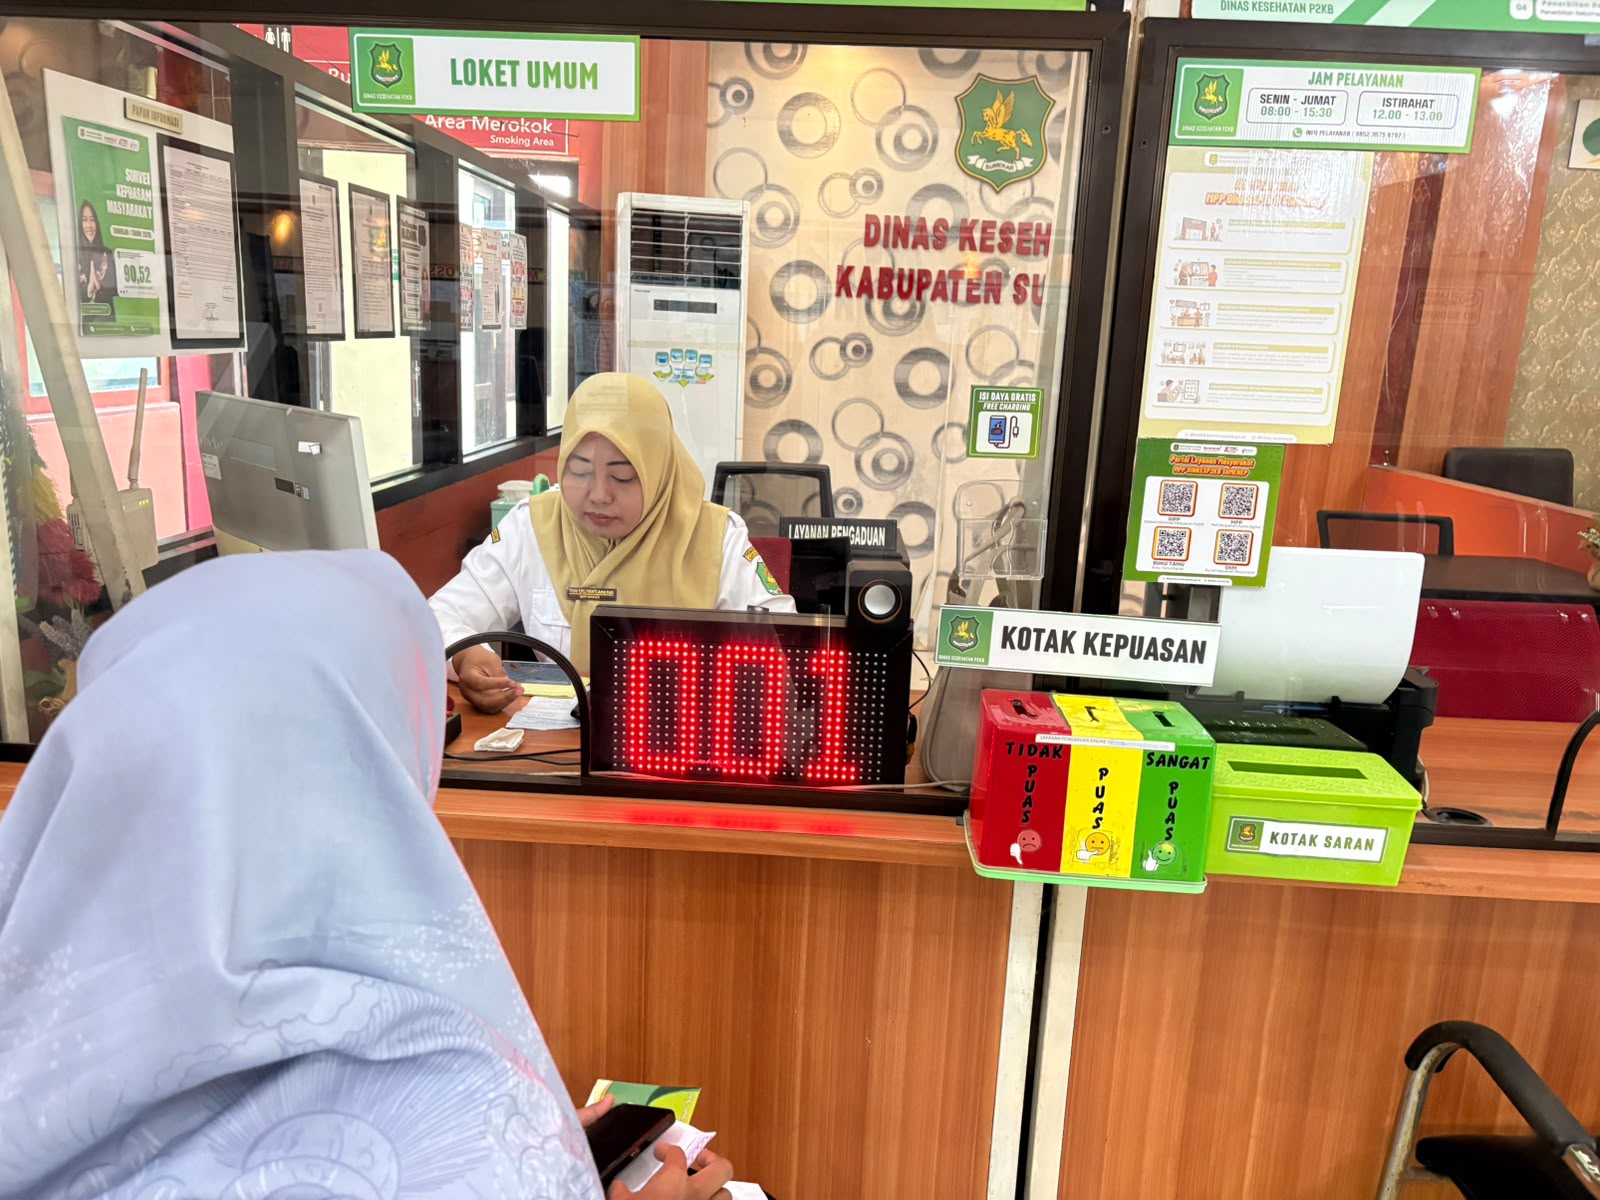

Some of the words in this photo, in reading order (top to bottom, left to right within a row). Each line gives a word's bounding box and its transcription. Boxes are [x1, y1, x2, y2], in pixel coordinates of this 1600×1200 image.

[1220, 0, 1249, 11] DINAS
[1251, 1, 1306, 13] KESEHATAN
[1309, 3, 1334, 14] P2KB
[450, 58, 520, 88] LOKET
[527, 60, 598, 90] UMUM
[1308, 71, 1335, 86] JAM
[1336, 72, 1404, 88] PELAYANAN
[1259, 93, 1290, 105] SENIN
[1300, 95, 1337, 106] JUMAT
[1382, 97, 1435, 110] ISTIRAHAT
[1260, 105, 1291, 117] 08:00
[1302, 107, 1333, 118] 15:30
[1372, 109, 1402, 120] 12.00
[1413, 110, 1443, 122] 13.00
[425, 113, 466, 129] Area
[472, 115, 552, 134] Merokok
[490, 134, 531, 147] Smoking
[533, 137, 554, 147] Area
[864, 213, 950, 250] DINAS
[123, 263, 152, 283] 90,52
[836, 264, 1004, 305] KABUPATEN
[979, 391, 990, 400] ISI
[990, 392, 1010, 401] DAYA
[1011, 393, 1036, 402] GRATIS
[983, 402, 999, 411] FREE
[999, 402, 1031, 411] CHARGING
[788, 524, 830, 539] LAYANAN
[831, 525, 886, 547] PENGADUAN
[1000, 625, 1077, 654] KOTAK
[1083, 631, 1208, 665] KEPUASAN
[628, 638, 857, 782] 001
[1006, 741, 1064, 760] TIDAK
[1146, 751, 1211, 770] SANGAT
[1021, 764, 1038, 824] PUAS
[1091, 767, 1110, 830] PUAS
[1164, 781, 1179, 842] PUAS
[1269, 831, 1319, 848] KOTAK
[1323, 835, 1375, 851] SARAN
